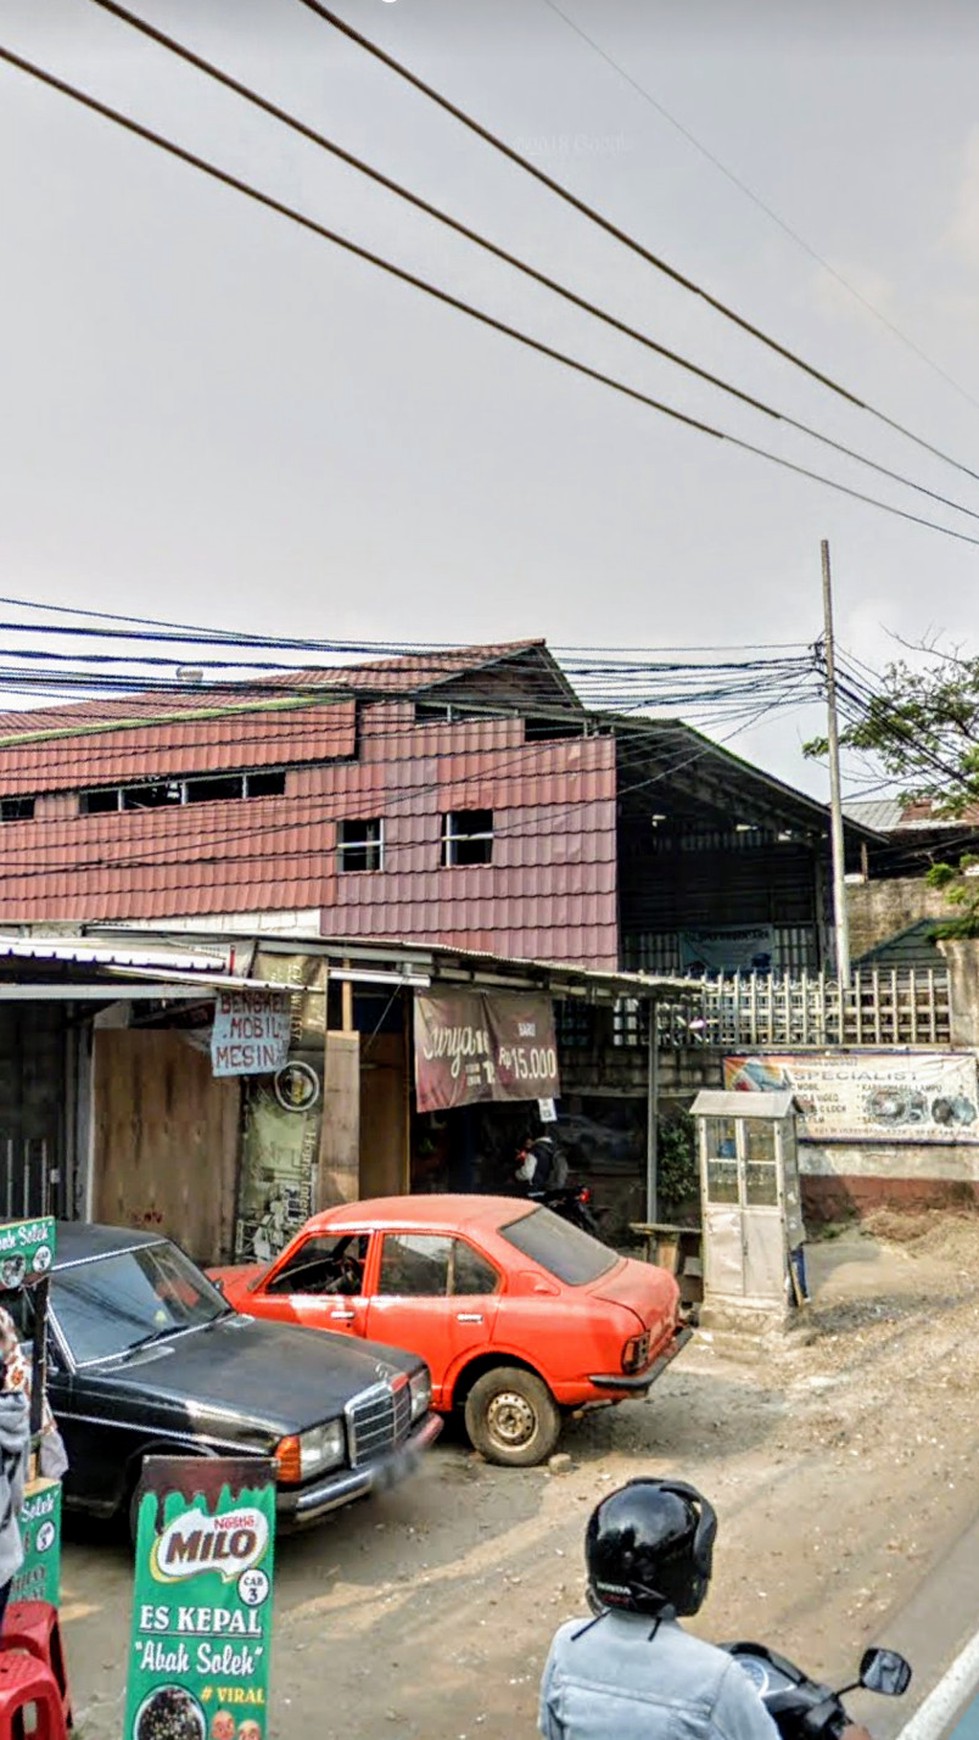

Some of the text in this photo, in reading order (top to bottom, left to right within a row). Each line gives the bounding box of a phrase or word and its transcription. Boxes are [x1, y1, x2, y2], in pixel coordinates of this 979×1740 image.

[216, 1045, 276, 1069] MESIN
[164, 1529, 257, 1565] MILO
[244, 1576, 264, 1587] CAB
[248, 1590, 258, 1603] 3
[139, 1604, 263, 1634] ES KEPAL
[217, 1686, 265, 1704] VIRAL
